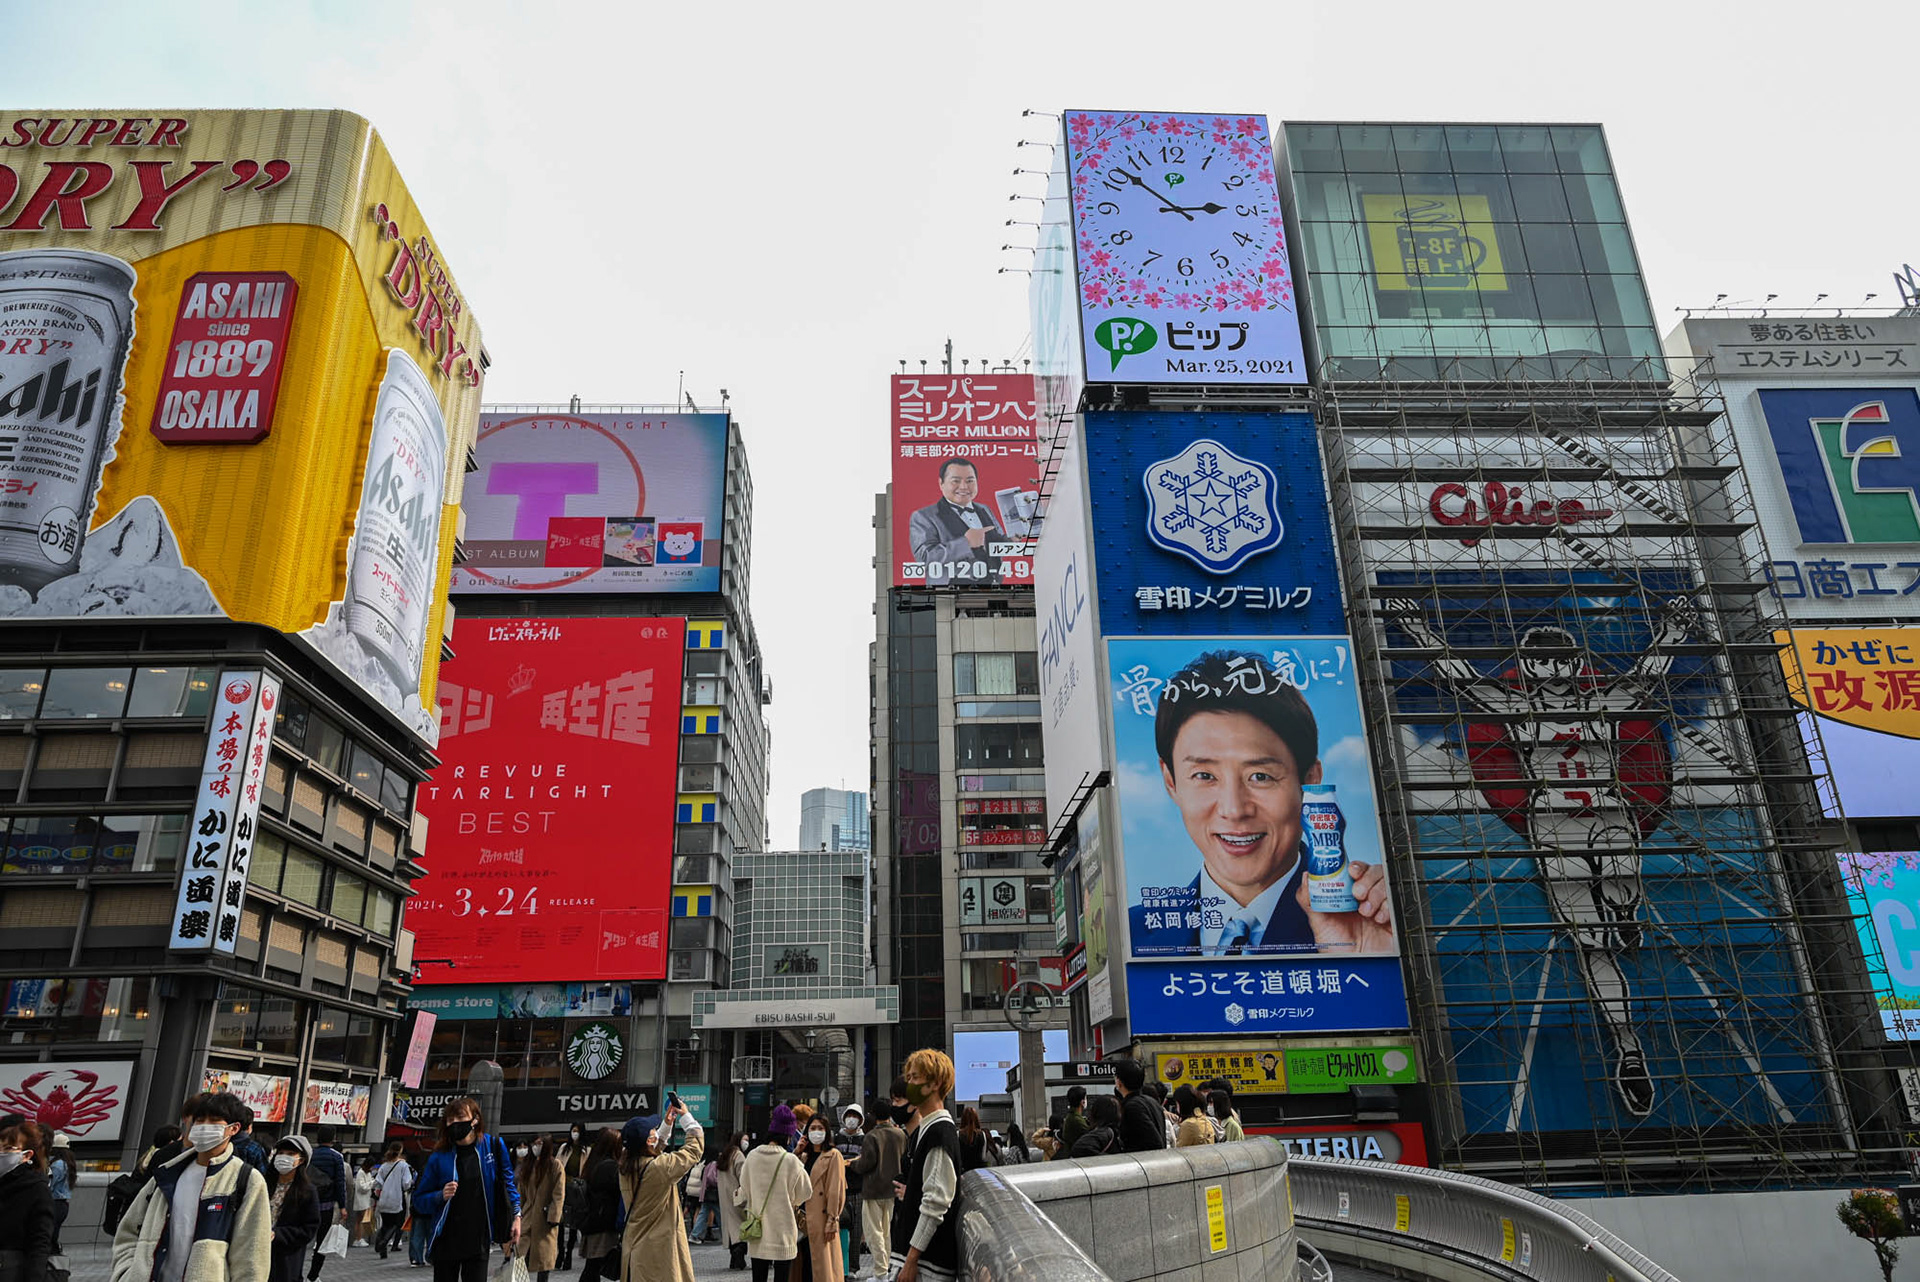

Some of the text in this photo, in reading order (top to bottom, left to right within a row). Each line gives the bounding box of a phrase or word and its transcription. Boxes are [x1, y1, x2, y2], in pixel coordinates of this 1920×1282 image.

[2, 117, 189, 149] SUPER
[1128, 150, 1152, 171] 11
[1159, 146, 1186, 164] 12
[1201, 155, 1213, 171] 1
[1221, 175, 1244, 191] 2
[1097, 201, 1121, 216] 9
[1235, 204, 1258, 218] 3
[1110, 229, 1134, 246] 8
[1232, 230, 1254, 248] 4
[1407, 238, 1457, 255] 7-8F
[1142, 249, 1164, 267] 7
[1177, 257, 1195, 277] 6
[1210, 249, 1230, 270] 5
[415, 236, 462, 324] SUPER
[183, 282, 286, 319] ASAHI
[3, 302, 78, 321] BREWERIES LIMITED
[2, 327, 48, 337] SUPER
[42, 319, 86, 332] BRAND
[207, 321, 250, 337] since
[1749, 323, 1875, 342] 夢ある住まい
[1165, 321, 1250, 351] ピップ
[172, 339, 274, 379] 1889
[1736, 349, 1909, 368] エステムシリーズ
[899, 378, 998, 400] スーパー
[160, 389, 260, 430] OSAKA
[22, 425, 48, 434] USING
[49, 428, 87, 444] CAREFULLY
[531, 421, 669, 430] STARLIGHT
[900, 425, 1030, 438] SUPER MILLION
[22, 445, 62, 458] BREWING
[43, 438, 85, 454] INGREDIENTS
[901, 445, 1038, 458] 薄毛部分のボリューム
[9, 464, 35, 474] ASAHI
[36, 468, 61, 479] SUPER
[19, 455, 80, 474] REFRESHING TASTE
[368, 452, 433, 562] Asahi
[40, 520, 78, 556] お酒
[386, 532, 406, 571] 生
[490, 549, 540, 559] ALBUM
[372, 563, 411, 609] スーパードライ
[469, 577, 486, 587] on
[492, 574, 519, 587] sale
[1135, 585, 1313, 611] 雪印メグミルク
[375, 619, 393, 646] 350ml
[1041, 551, 1085, 697] FANCL
[1810, 638, 1915, 667] かぜに
[208, 710, 244, 799] 本場の味
[245, 716, 268, 805] 本場の味
[454, 764, 568, 778] REVUE
[458, 811, 556, 835] BEST
[966, 831, 980, 844] 5F
[1312, 832, 1341, 848] MBP
[1317, 860, 1340, 868] ドリンク
[1141, 887, 1198, 898] 雪印メグミルク
[549, 898, 596, 906] RELEASE
[1144, 911, 1225, 930] 松岡修造
[783, 947, 810, 958] なんば
[1161, 968, 1371, 998] ようこそ道頓堀へ
[455, 989, 494, 1008] store
[755, 1012, 836, 1023] EBISU BASHI-SUJI
[1246, 1006, 1315, 1020] 雪印メグミルク
[1188, 1056, 1254, 1069] 店舗情報館
[1326, 1051, 1380, 1078] ピタットハウス
[558, 1093, 650, 1112] TSUTAYA
[680, 1094, 707, 1102] osme
